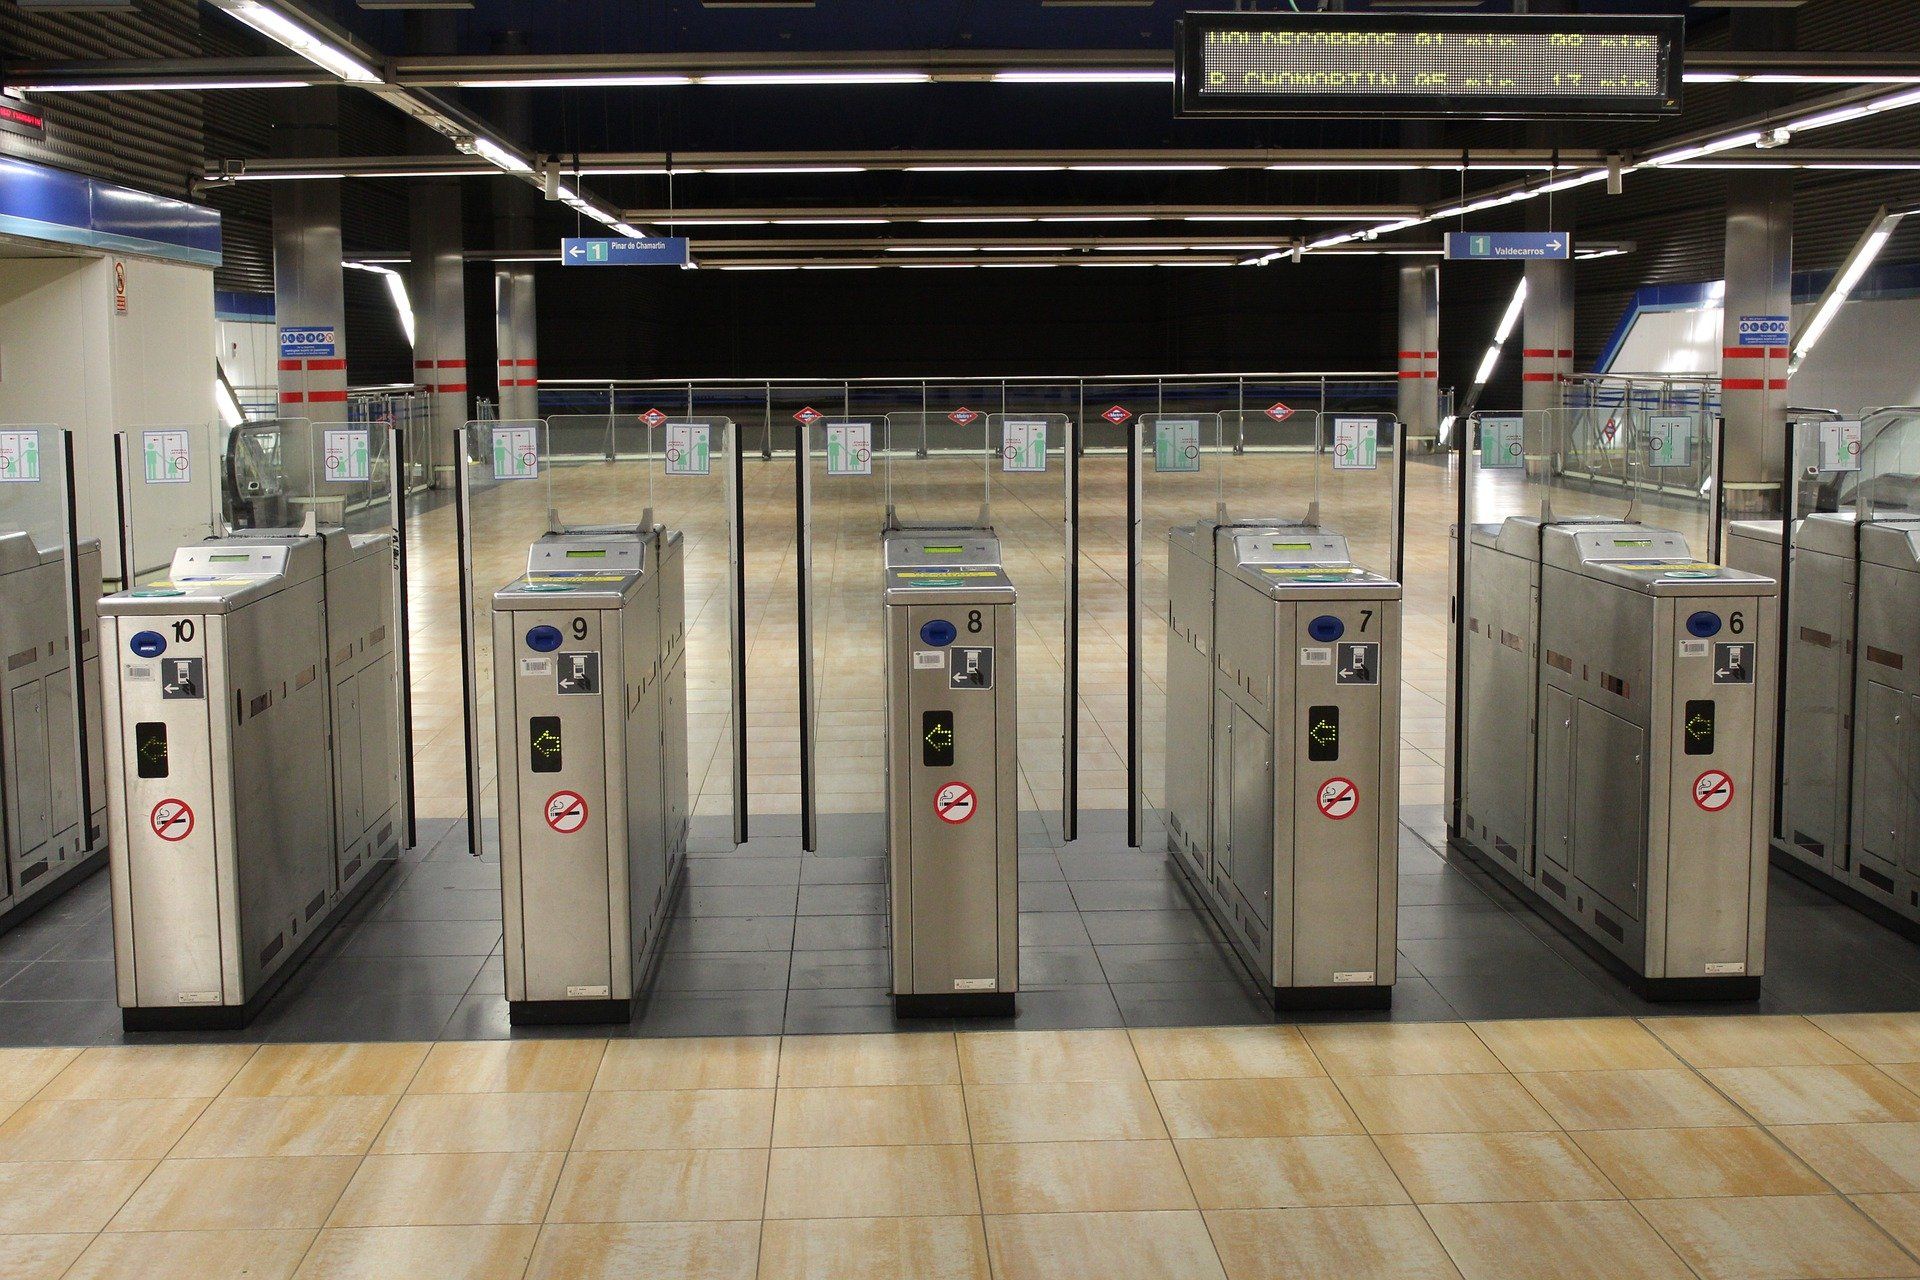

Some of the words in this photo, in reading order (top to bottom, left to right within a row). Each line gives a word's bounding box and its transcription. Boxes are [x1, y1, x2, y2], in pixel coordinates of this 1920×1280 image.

[592, 244, 600, 259] 1
[611, 241, 627, 250] Pinar
[627, 241, 635, 250] de
[1475, 237, 1484, 253] 1
[1494, 247, 1545, 255] Valdecarros
[171, 618, 195, 643] 10
[572, 616, 588, 641] 9
[967, 609, 982, 633] 8
[1360, 609, 1373, 632] 7
[1729, 611, 1744, 634] 6
